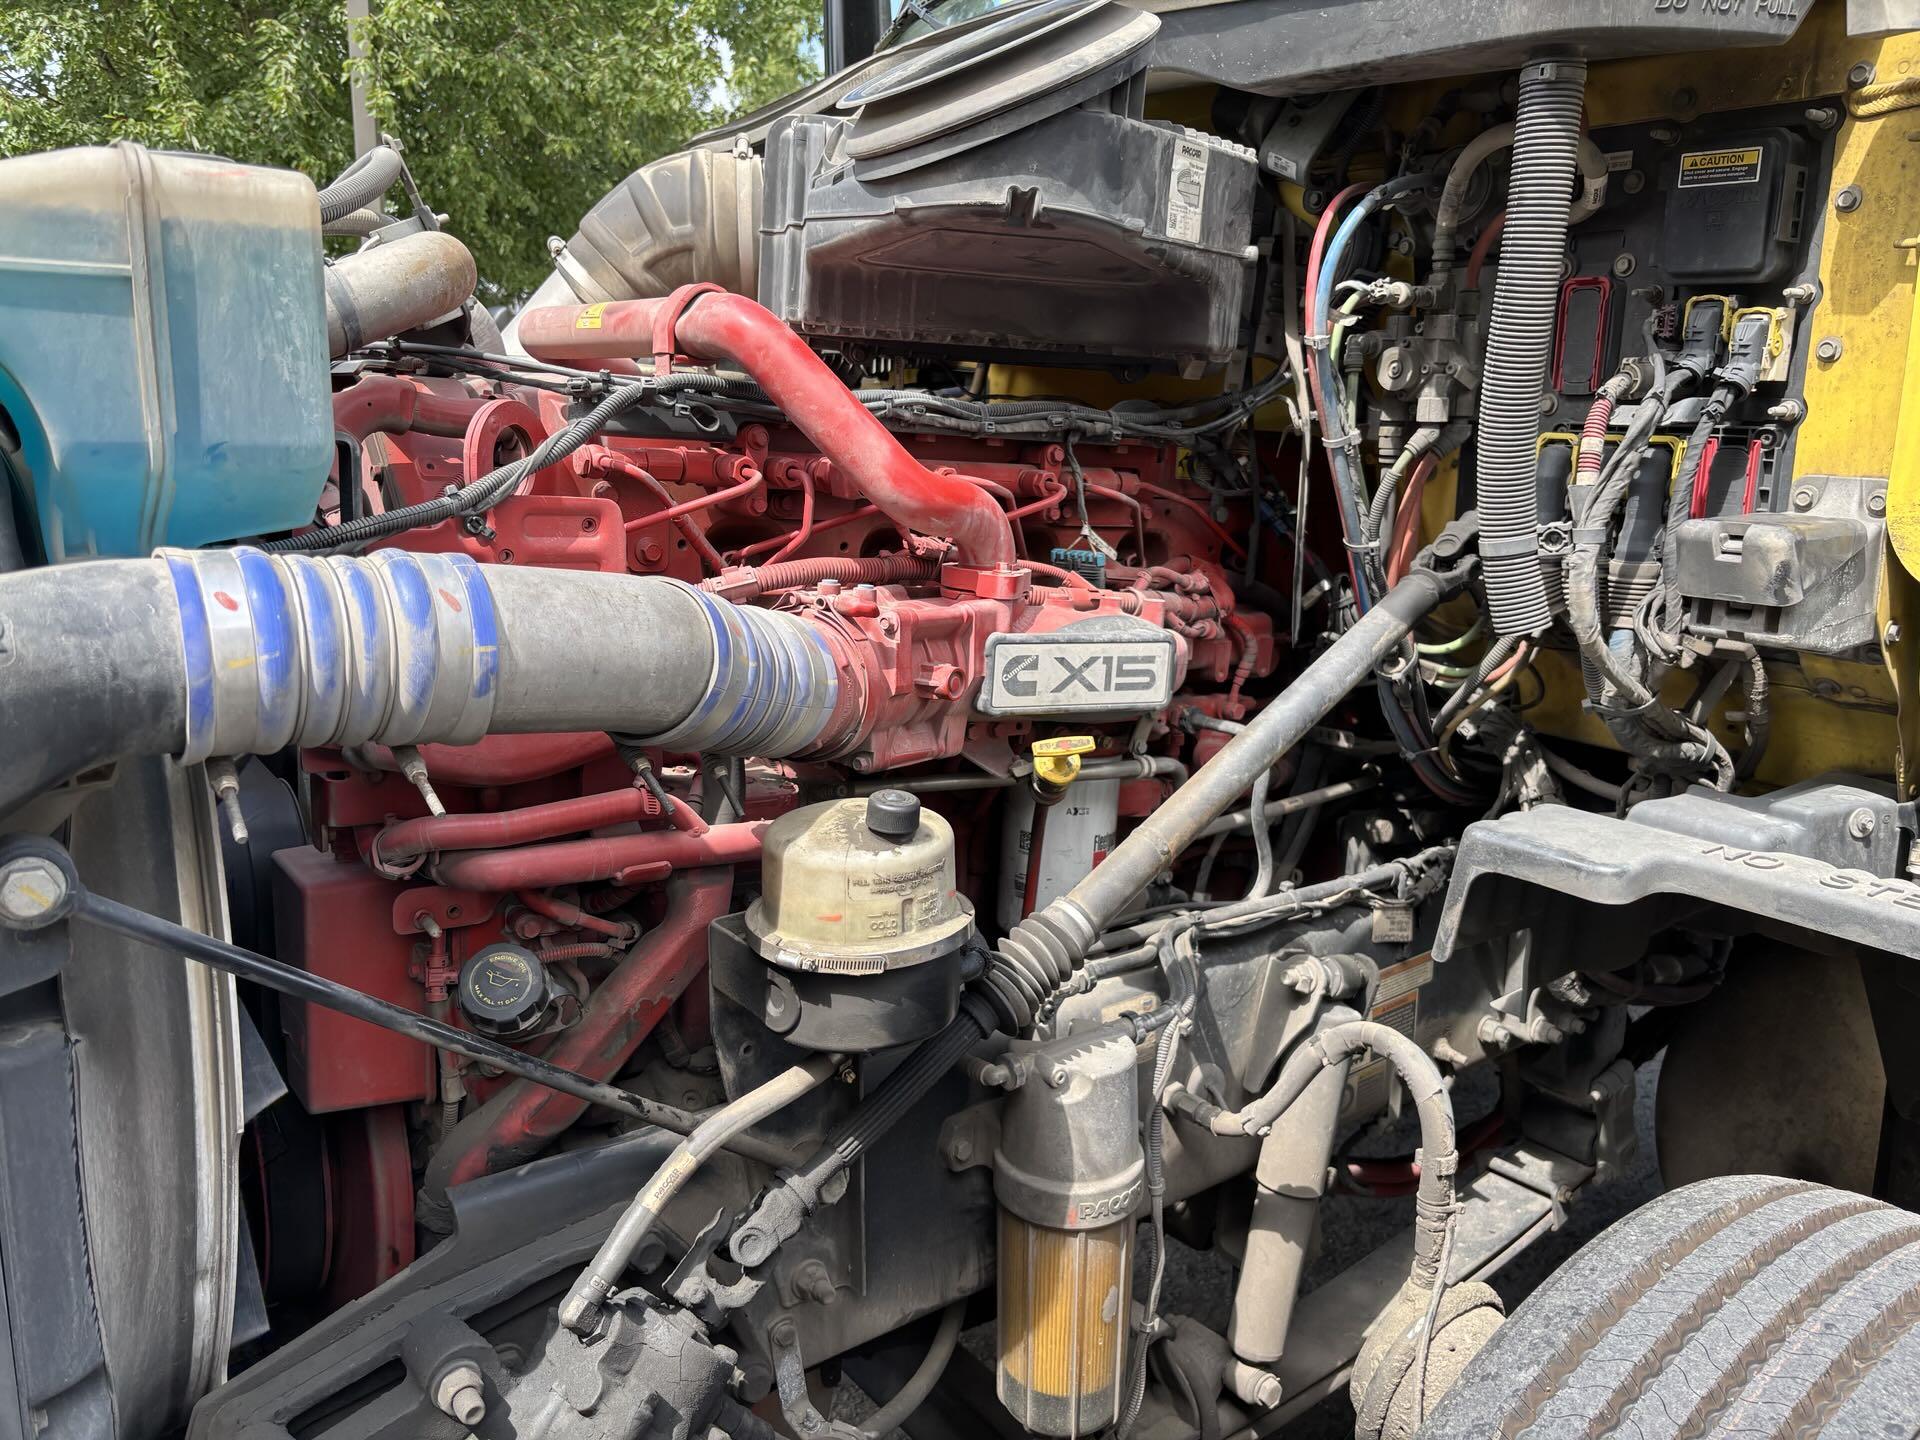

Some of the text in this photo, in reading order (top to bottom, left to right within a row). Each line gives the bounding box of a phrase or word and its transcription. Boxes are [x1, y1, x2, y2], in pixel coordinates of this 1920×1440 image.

[1701, 0, 1742, 14] NOT
[1754, 0, 1798, 18] PULL
[1700, 154, 1745, 167] CAUTION
[1050, 656, 1157, 694] X15
[1702, 846, 1785, 870] NO
[870, 919, 898, 931] COLD
[489, 955, 528, 974] ENGINE OIL
[474, 984, 484, 998] MAX
[483, 997, 495, 1006] FILL
[505, 996, 519, 1006] GAL
[1079, 1180, 1142, 1220] PACC
